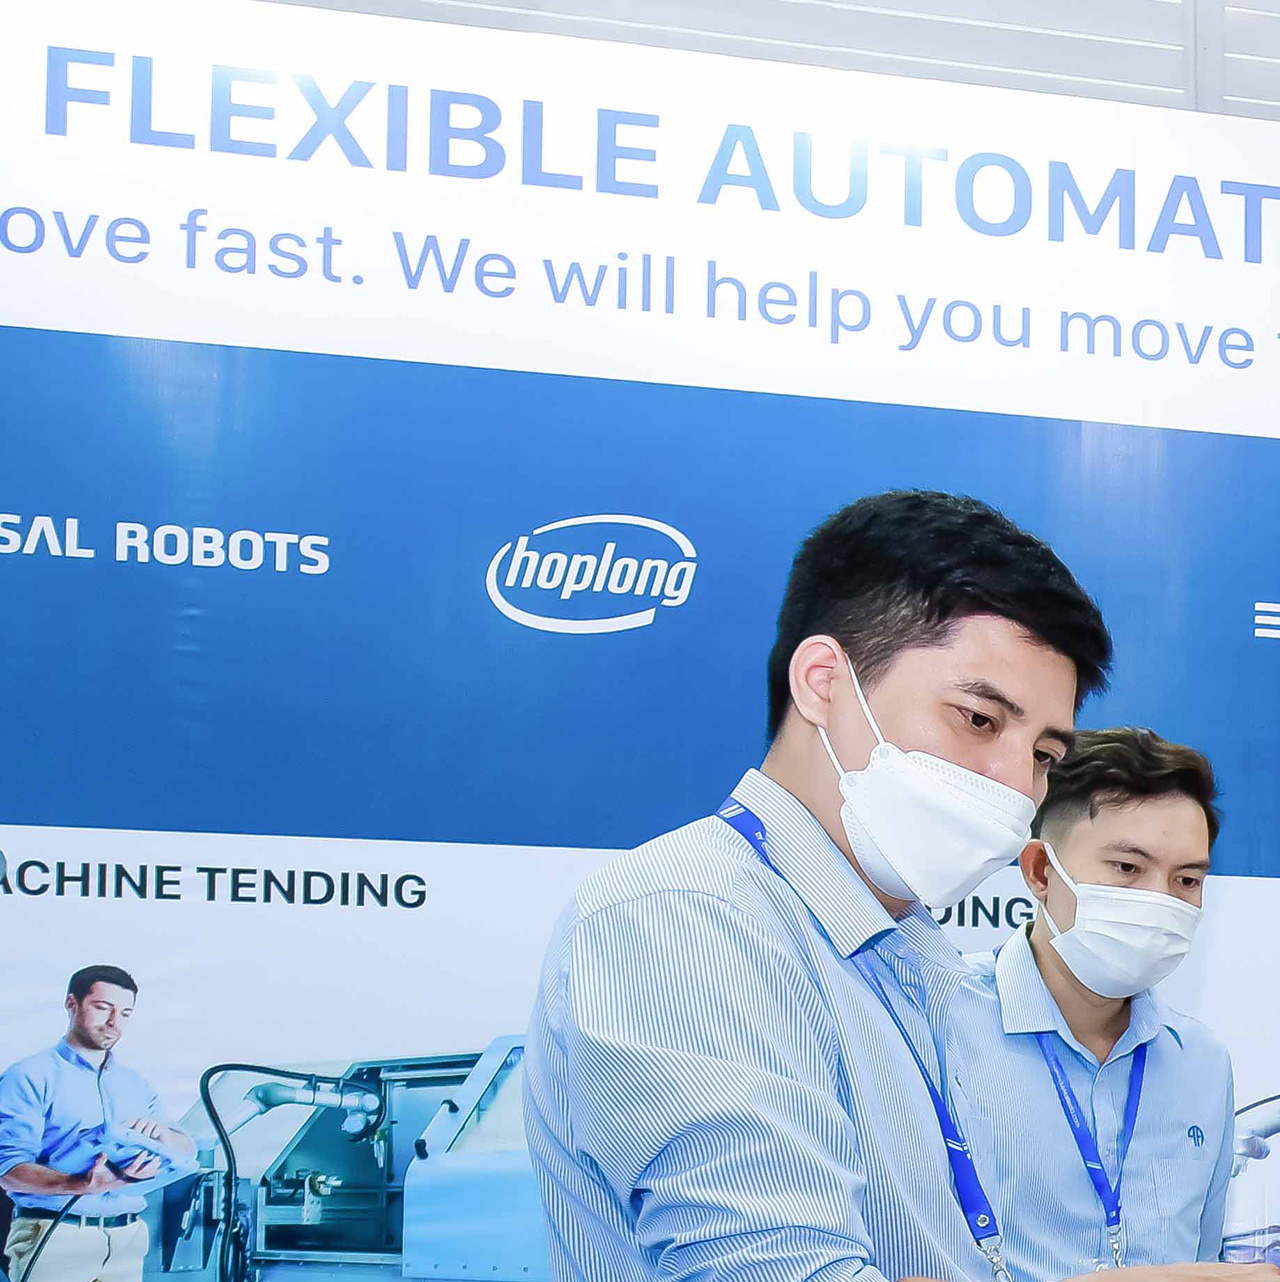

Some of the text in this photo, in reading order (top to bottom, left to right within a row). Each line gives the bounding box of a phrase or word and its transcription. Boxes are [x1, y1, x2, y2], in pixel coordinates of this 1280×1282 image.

[44, 45, 660, 199] FLEXIBLE
[0, 206, 151, 264] ove
[180, 208, 364, 285] fast.
[393, 231, 518, 298] We
[543, 251, 675, 315] will
[707, 260, 871, 344] help
[896, 292, 1031, 351] you
[1060, 309, 1255, 369] move
[115, 521, 330, 575] ROBOTS
[503, 536, 698, 607] hoplong
[197, 866, 428, 911] TENDING
